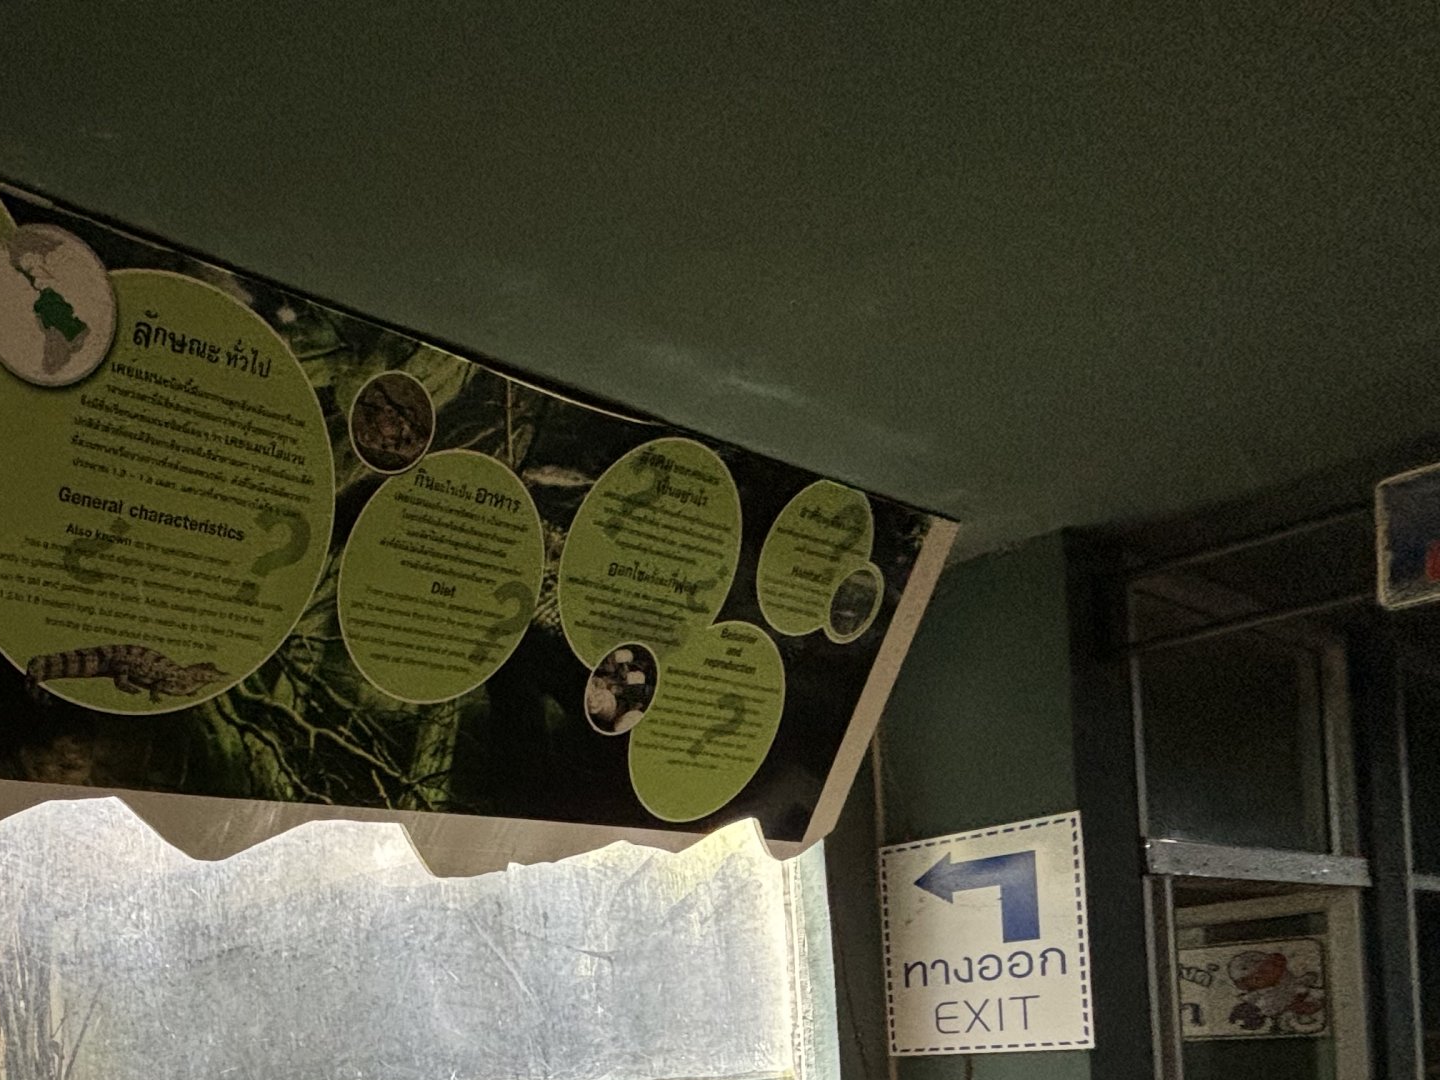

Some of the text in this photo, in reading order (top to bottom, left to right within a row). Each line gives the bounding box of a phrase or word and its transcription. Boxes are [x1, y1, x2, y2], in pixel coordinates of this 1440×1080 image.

[58, 486, 245, 542] General characteristics
[65, 522, 92, 540] Also
[95, 529, 132, 547] known
[431, 581, 457, 598] Diet
[903, 947, 1067, 988] ทางออก
[935, 995, 1041, 1035] EXIT
